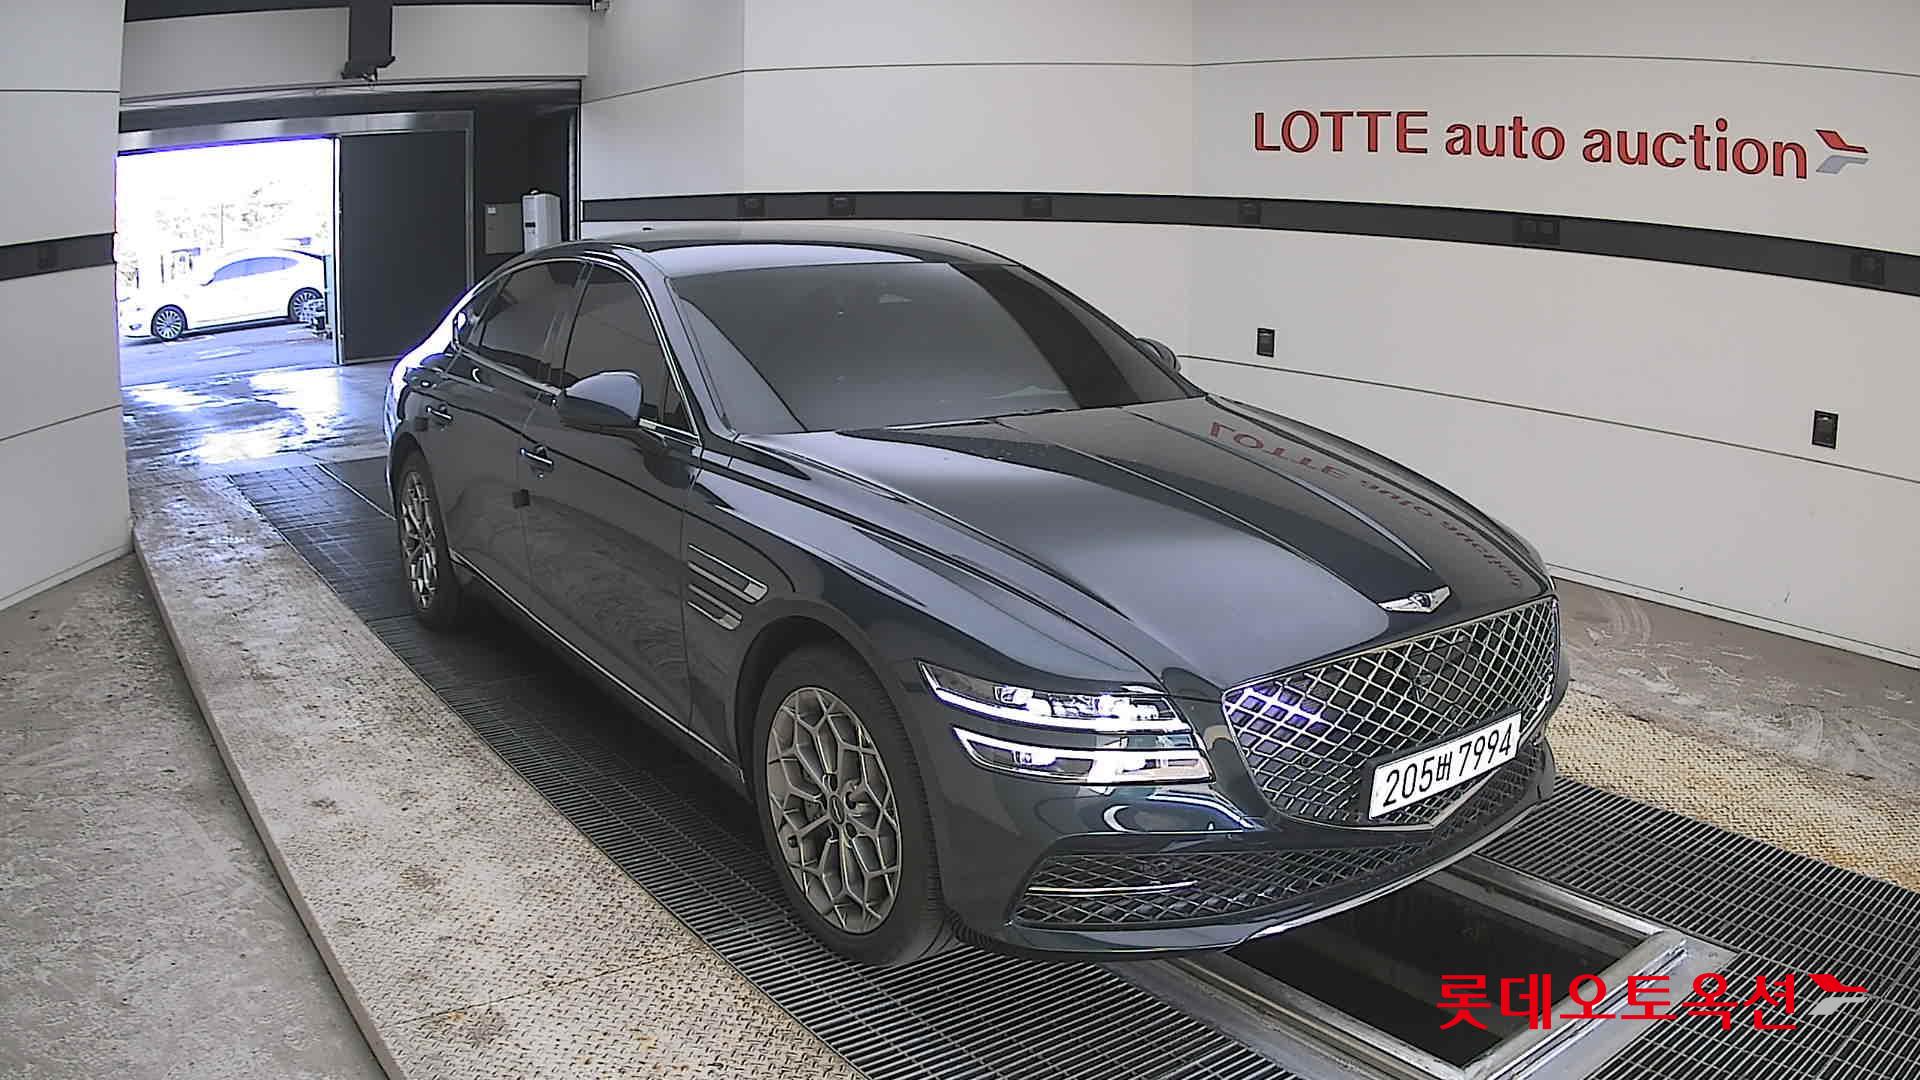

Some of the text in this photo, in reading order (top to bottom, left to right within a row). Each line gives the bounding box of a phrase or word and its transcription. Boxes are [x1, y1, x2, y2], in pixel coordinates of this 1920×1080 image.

[1253, 110, 1809, 179] LOTTE auto auction
[1458, 722, 1513, 778] 7994
